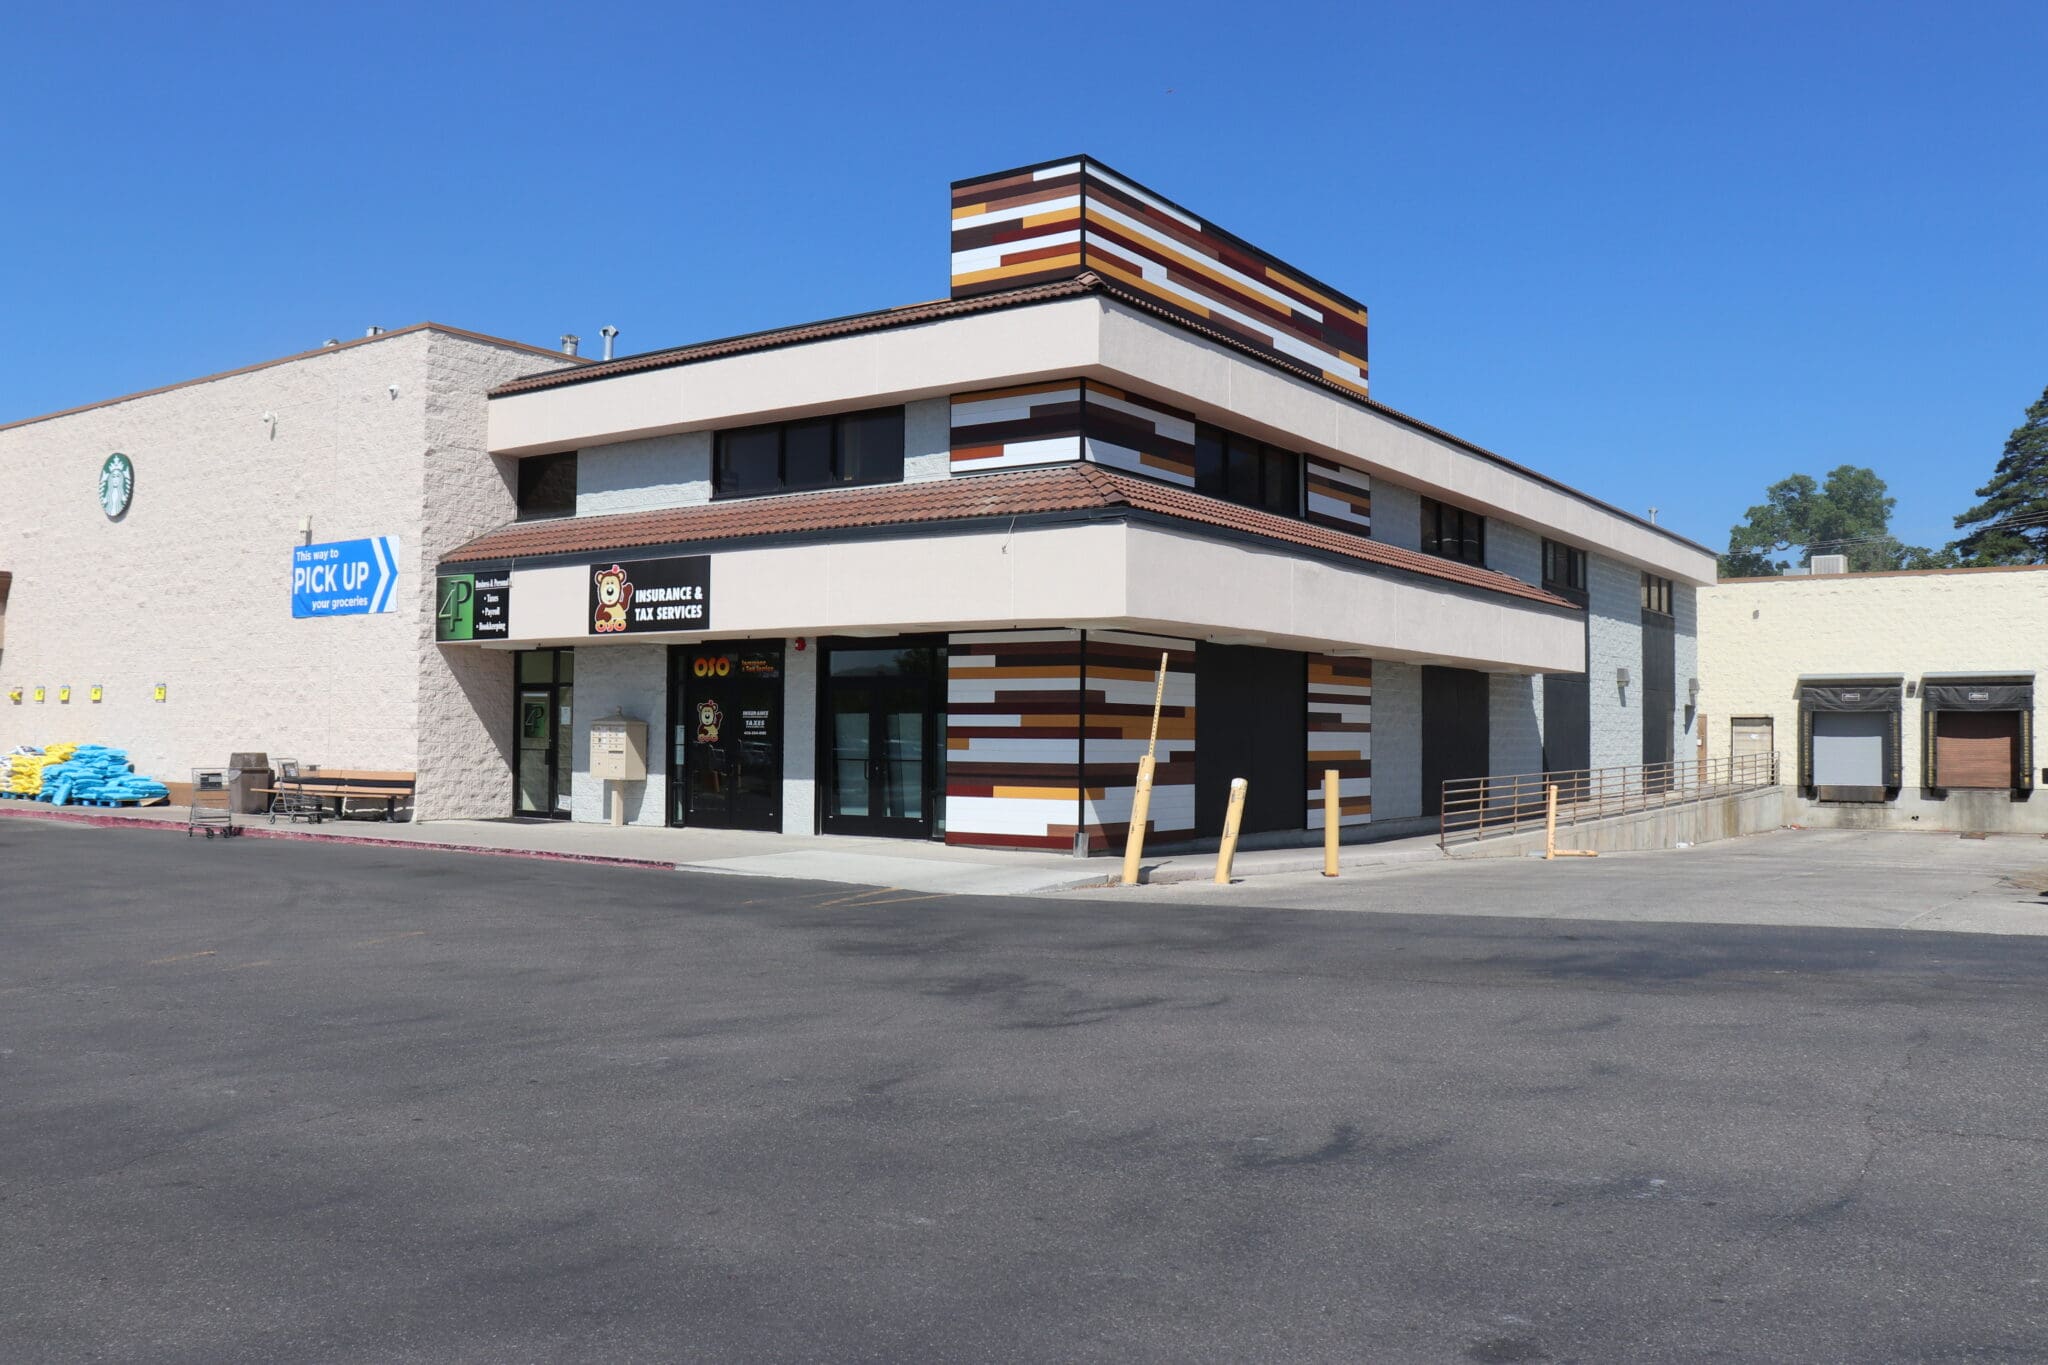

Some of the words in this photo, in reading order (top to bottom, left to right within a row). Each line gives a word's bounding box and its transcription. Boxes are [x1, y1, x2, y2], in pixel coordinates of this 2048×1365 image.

[296, 551, 312, 562] This
[313, 550, 328, 561] way
[330, 549, 339, 559] to
[294, 564, 338, 594] PICK
[343, 561, 369, 590] UP
[635, 586, 692, 603] INSURANCE
[694, 586, 703, 600] &
[312, 600, 330, 611] your
[332, 595, 368, 609] groceries
[635, 607, 654, 621] TAX
[656, 605, 702, 620] SERVICES
[694, 657, 730, 677] OSO
